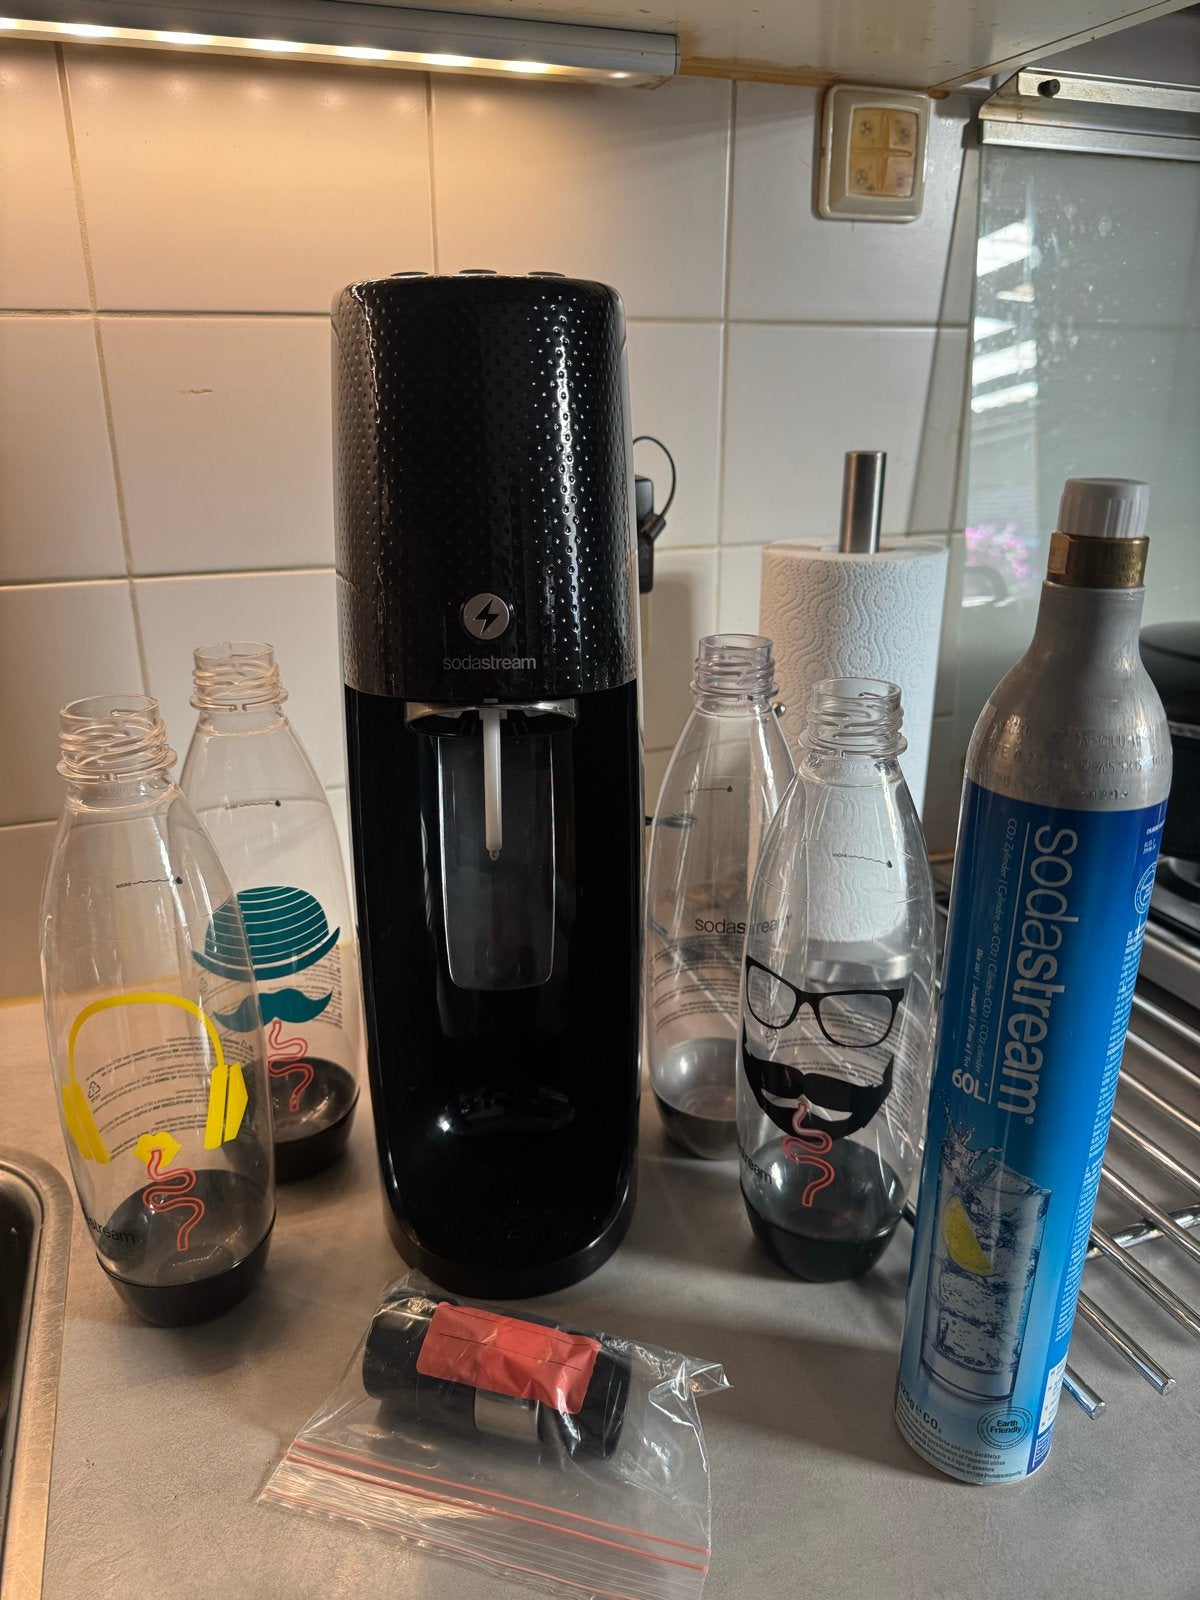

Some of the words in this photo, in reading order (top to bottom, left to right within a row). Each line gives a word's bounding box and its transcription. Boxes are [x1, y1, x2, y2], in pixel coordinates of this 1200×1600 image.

[442, 654, 537, 670] sodastream
[1001, 842, 1015, 877] Zylinder
[994, 885, 1008, 915] Cylindre
[990, 936, 1001, 957] CO2
[985, 963, 998, 996] Cilindro
[982, 998, 993, 1018] CO2
[952, 1068, 986, 1102] 60L
[990, 1425, 1022, 1434] Friendly
[996, 1419, 1018, 1427] Earth
